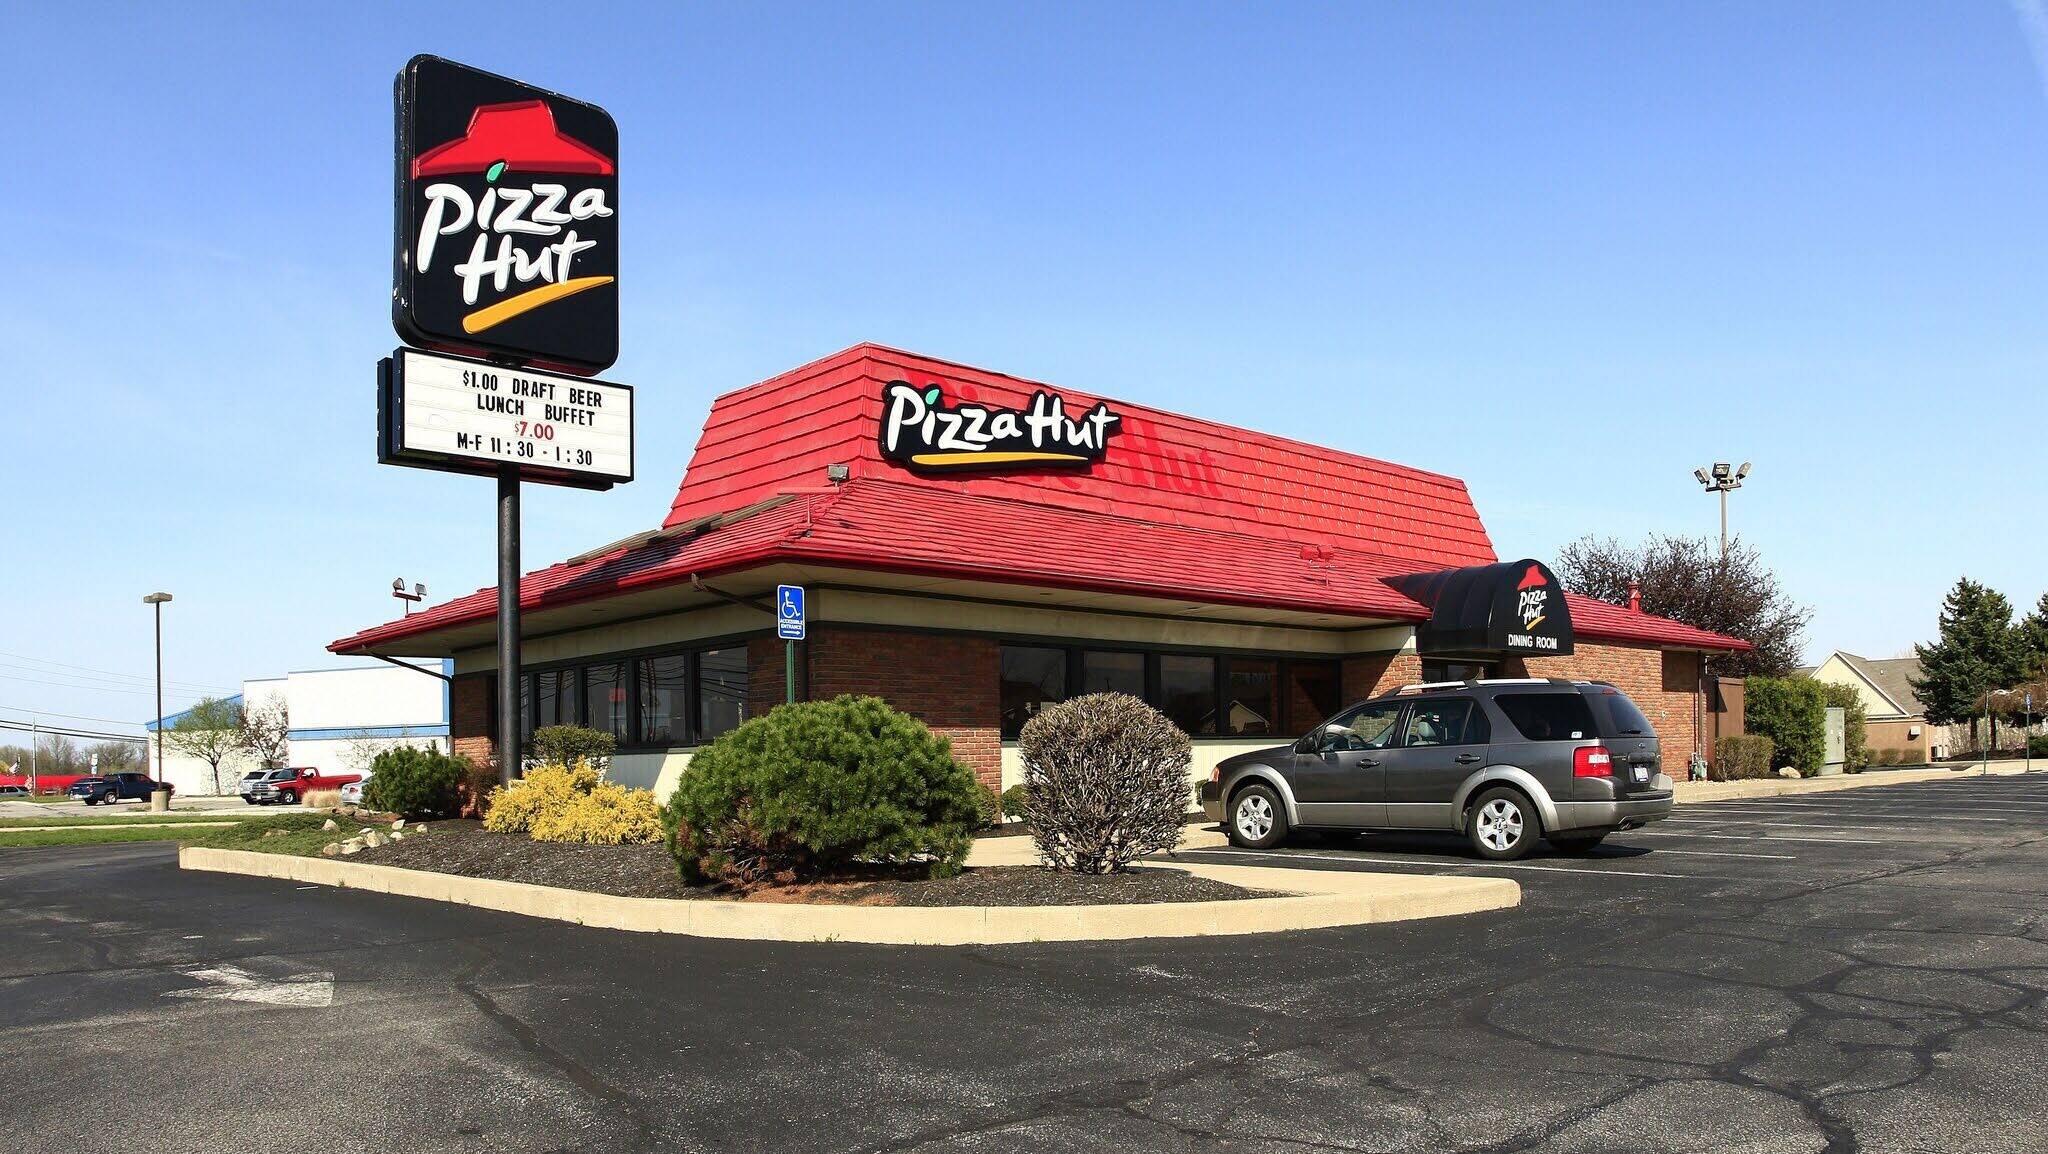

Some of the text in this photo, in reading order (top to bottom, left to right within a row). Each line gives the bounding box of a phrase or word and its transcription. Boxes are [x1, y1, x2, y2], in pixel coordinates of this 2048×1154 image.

[417, 162, 614, 274] Pizza
[453, 230, 598, 306] Hut
[463, 370, 602, 408] $1.00 DRAFT BEER
[477, 394, 595, 426] LUNCH BUFFET
[887, 385, 1120, 452] Pizza Hut
[457, 432, 482, 451] M-F
[514, 421, 554, 440] $7.00
[1517, 586, 1547, 616] Pizza
[1523, 603, 1544, 625] Hut
[1508, 634, 1558, 649] DINING ROOM
